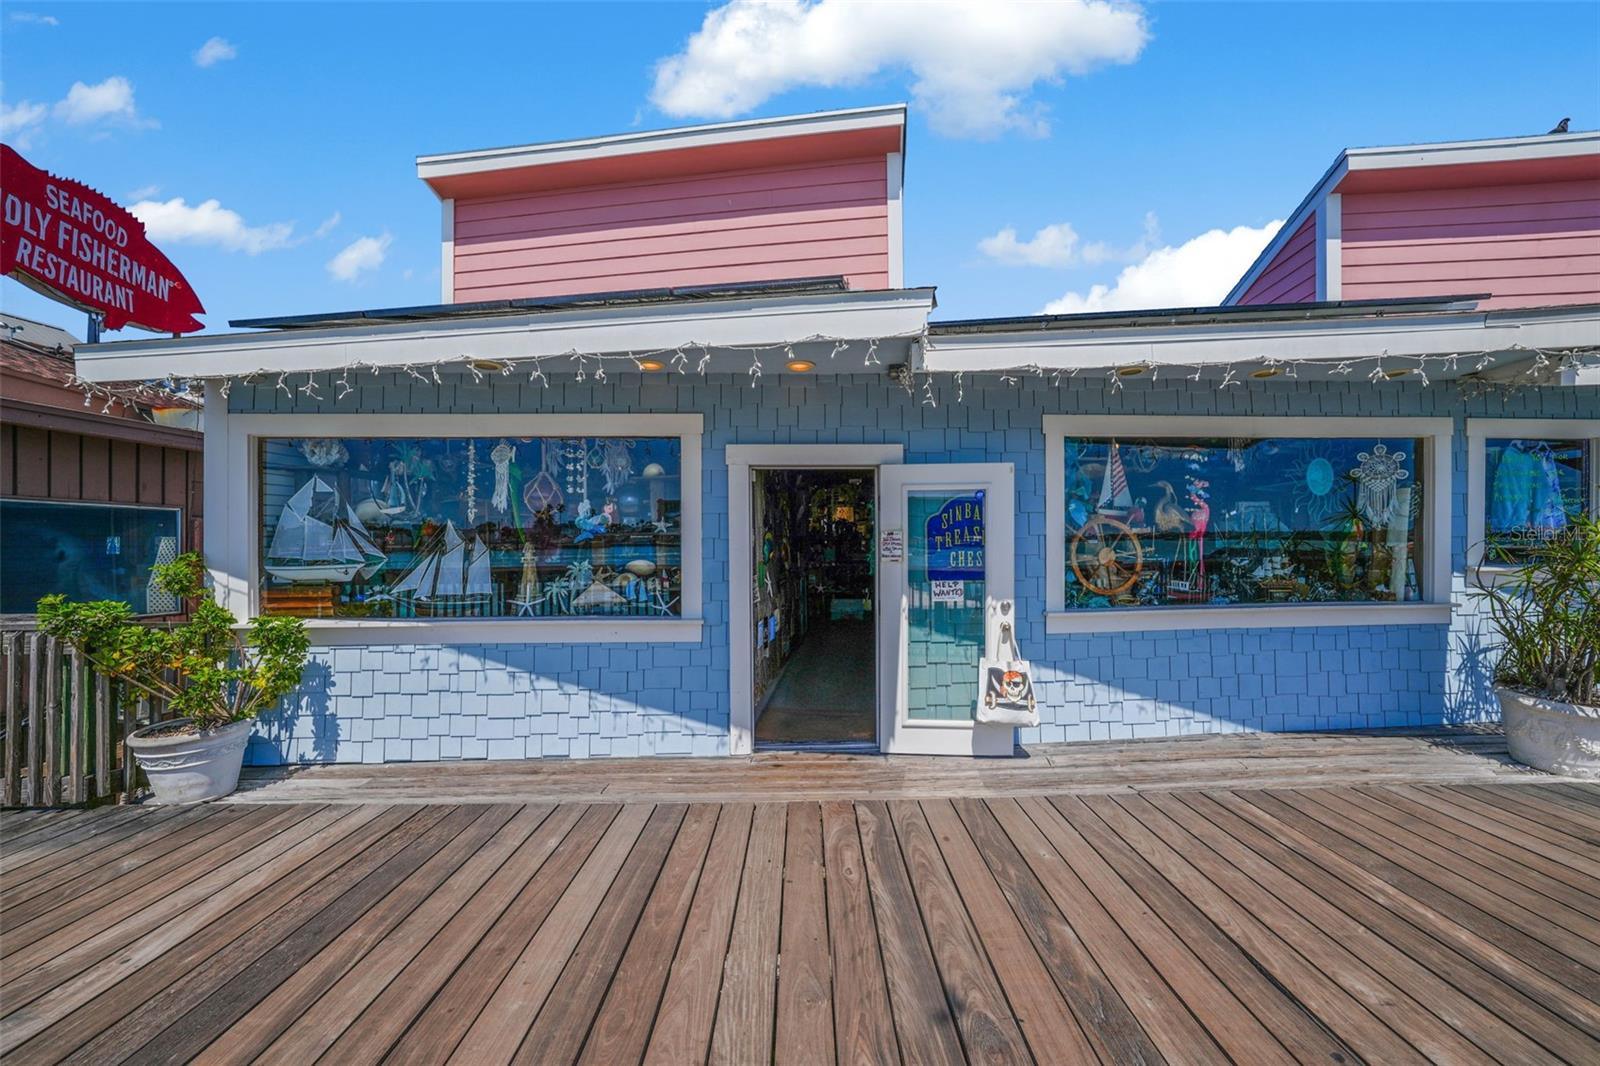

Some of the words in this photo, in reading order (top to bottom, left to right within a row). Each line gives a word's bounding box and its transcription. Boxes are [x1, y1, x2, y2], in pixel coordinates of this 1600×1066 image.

[0, 187, 52, 241] DLY
[46, 184, 128, 248] SEAFOOD
[16, 237, 134, 313] RESTAURANT
[941, 502, 986, 529] SINBA
[950, 550, 983, 568] CHES
[935, 581, 960, 589] HELP
